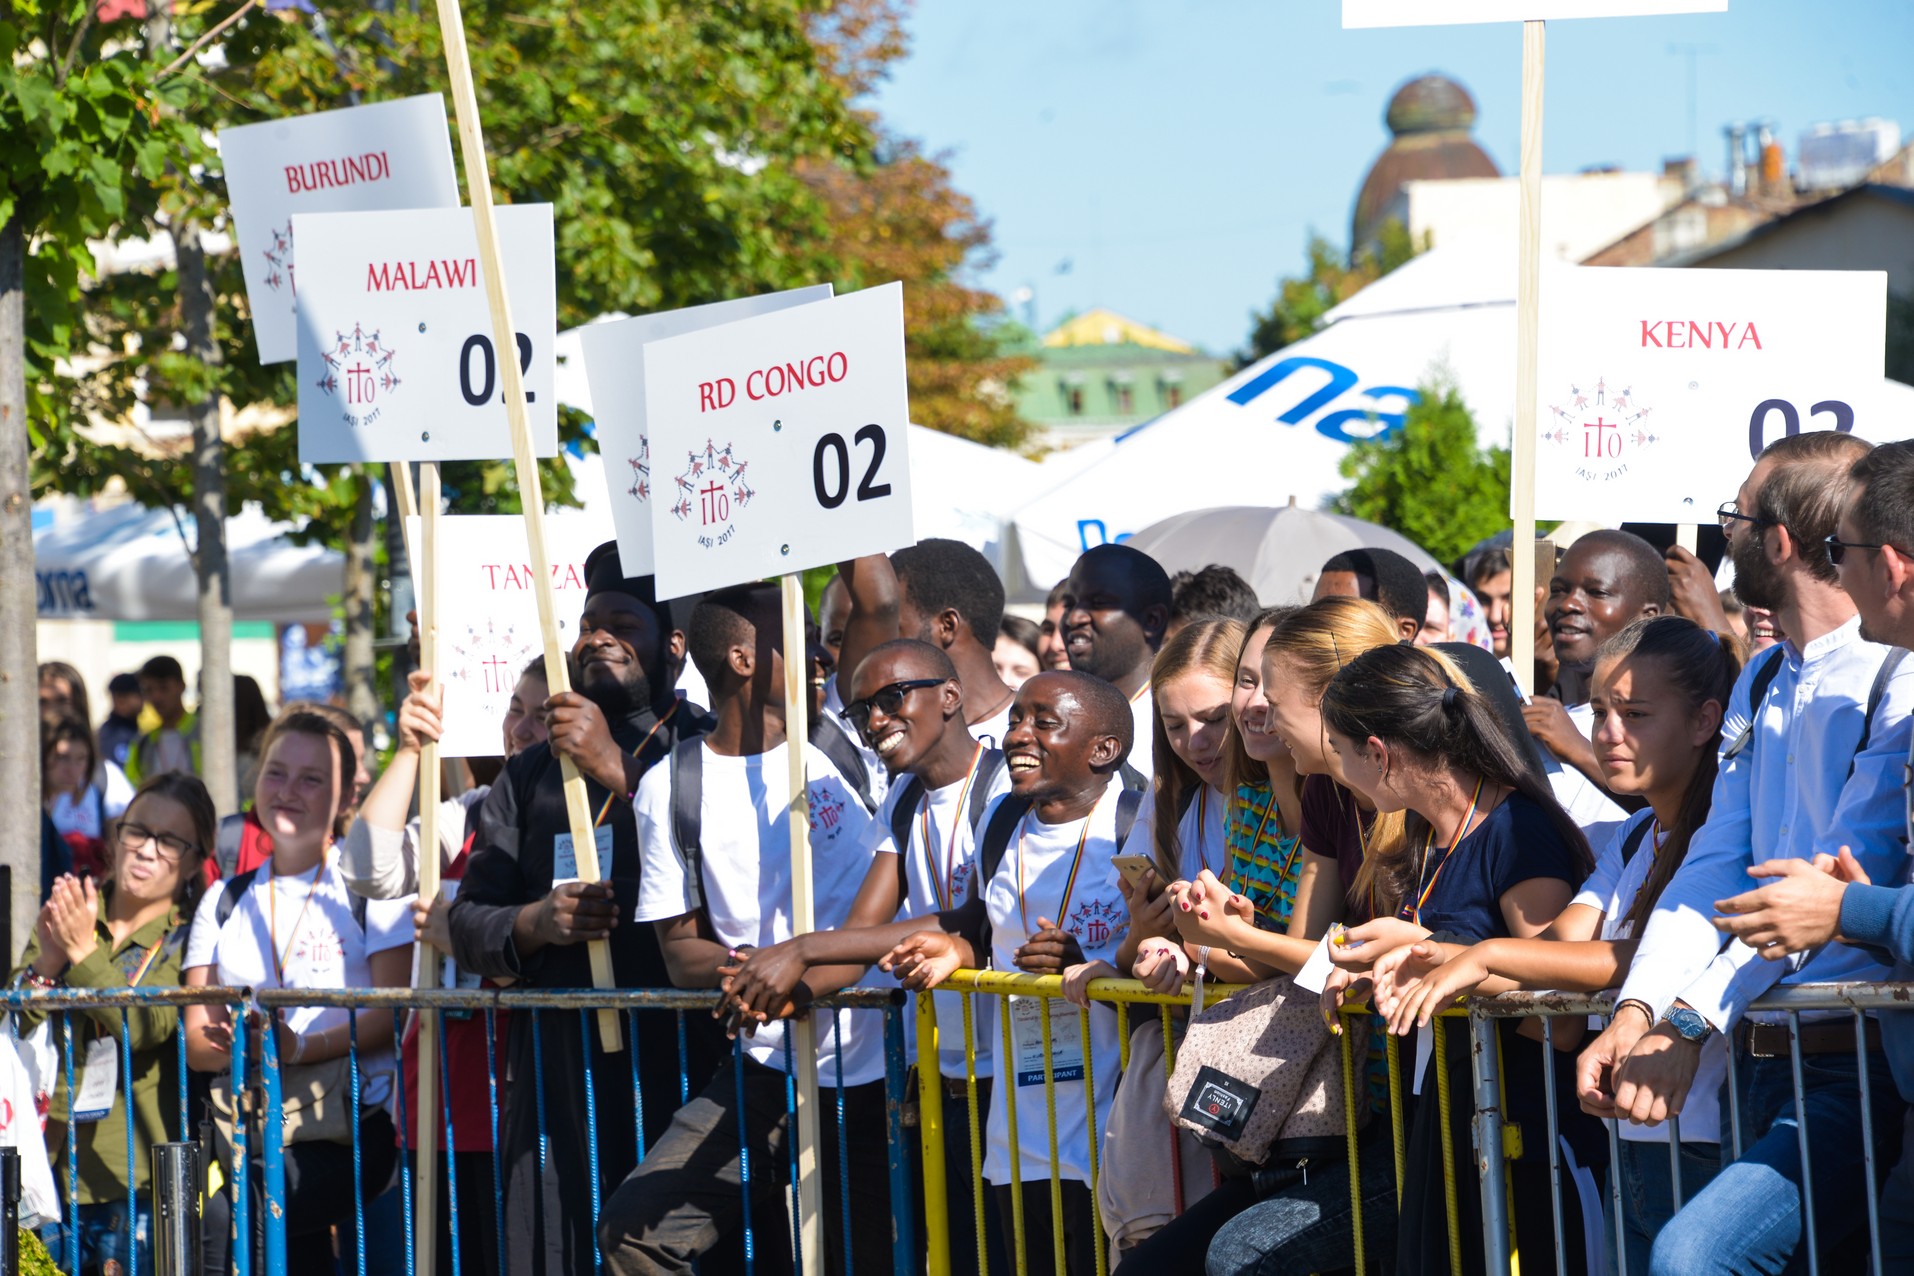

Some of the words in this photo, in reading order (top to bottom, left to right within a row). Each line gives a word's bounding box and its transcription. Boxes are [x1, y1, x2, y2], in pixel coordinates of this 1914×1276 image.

[284, 151, 390, 194] BURUNDI
[366, 258, 477, 292] MALAWI
[1639, 319, 1763, 350] KENYA
[698, 377, 736, 413] RD
[746, 351, 848, 401] CONGO
[812, 423, 892, 510] 02
[717, 524, 736, 546] 2017
